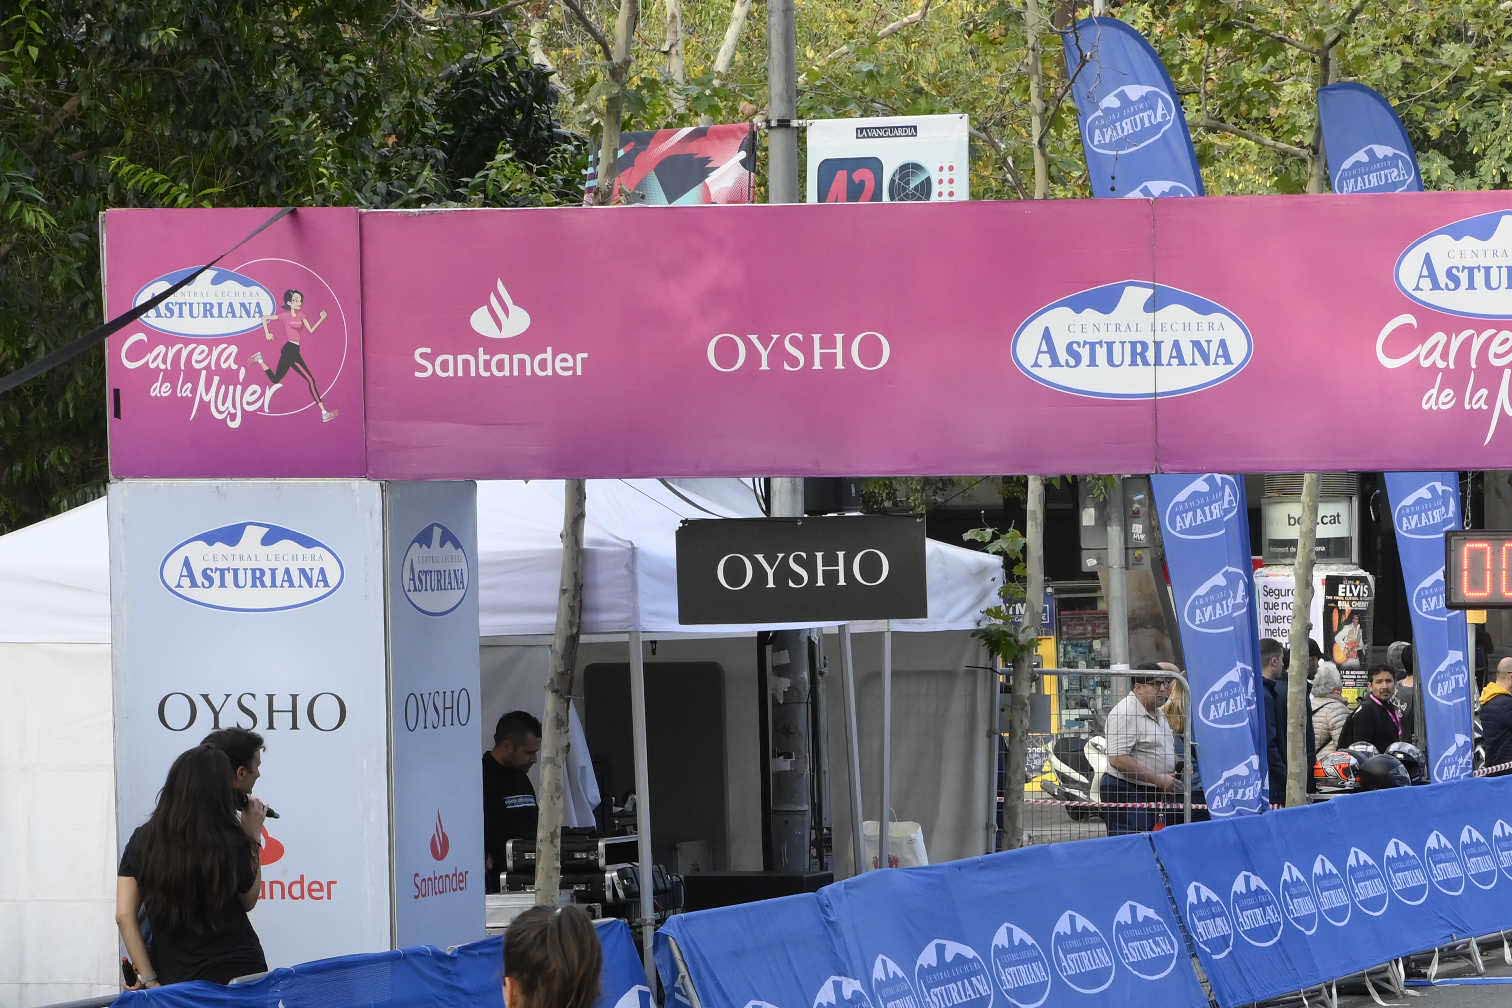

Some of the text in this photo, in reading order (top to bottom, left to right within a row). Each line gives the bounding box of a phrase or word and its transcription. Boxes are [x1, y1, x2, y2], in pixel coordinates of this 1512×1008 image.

[168, 288, 261, 298] ENTRAL LECHERA
[1067, 320, 1226, 334] CENTRAL LECHERA
[121, 333, 243, 370] Carrera
[414, 346, 589, 378] Santander
[707, 331, 890, 372] OYSHO
[1030, 326, 1235, 368] ASTURIANA
[150, 367, 283, 428] de la Mujer
[1421, 373, 1457, 411] de
[1463, 373, 1489, 411] la
[174, 555, 332, 590] ASTURIANA
[202, 552, 325, 562] CENTRAL LECHERA
[716, 547, 891, 591] OYSHO
[407, 558, 466, 593] ASTURIANA
[1338, 584, 1368, 597] ELVIS
[1264, 602, 1279, 612] que
[157, 691, 347, 732] OYSHO
[404, 687, 471, 733] OYSHO
[413, 867, 470, 899] Santander
[996, 958, 1048, 991] ASTURIANA
[1057, 943, 1112, 977] ASTURIANA
